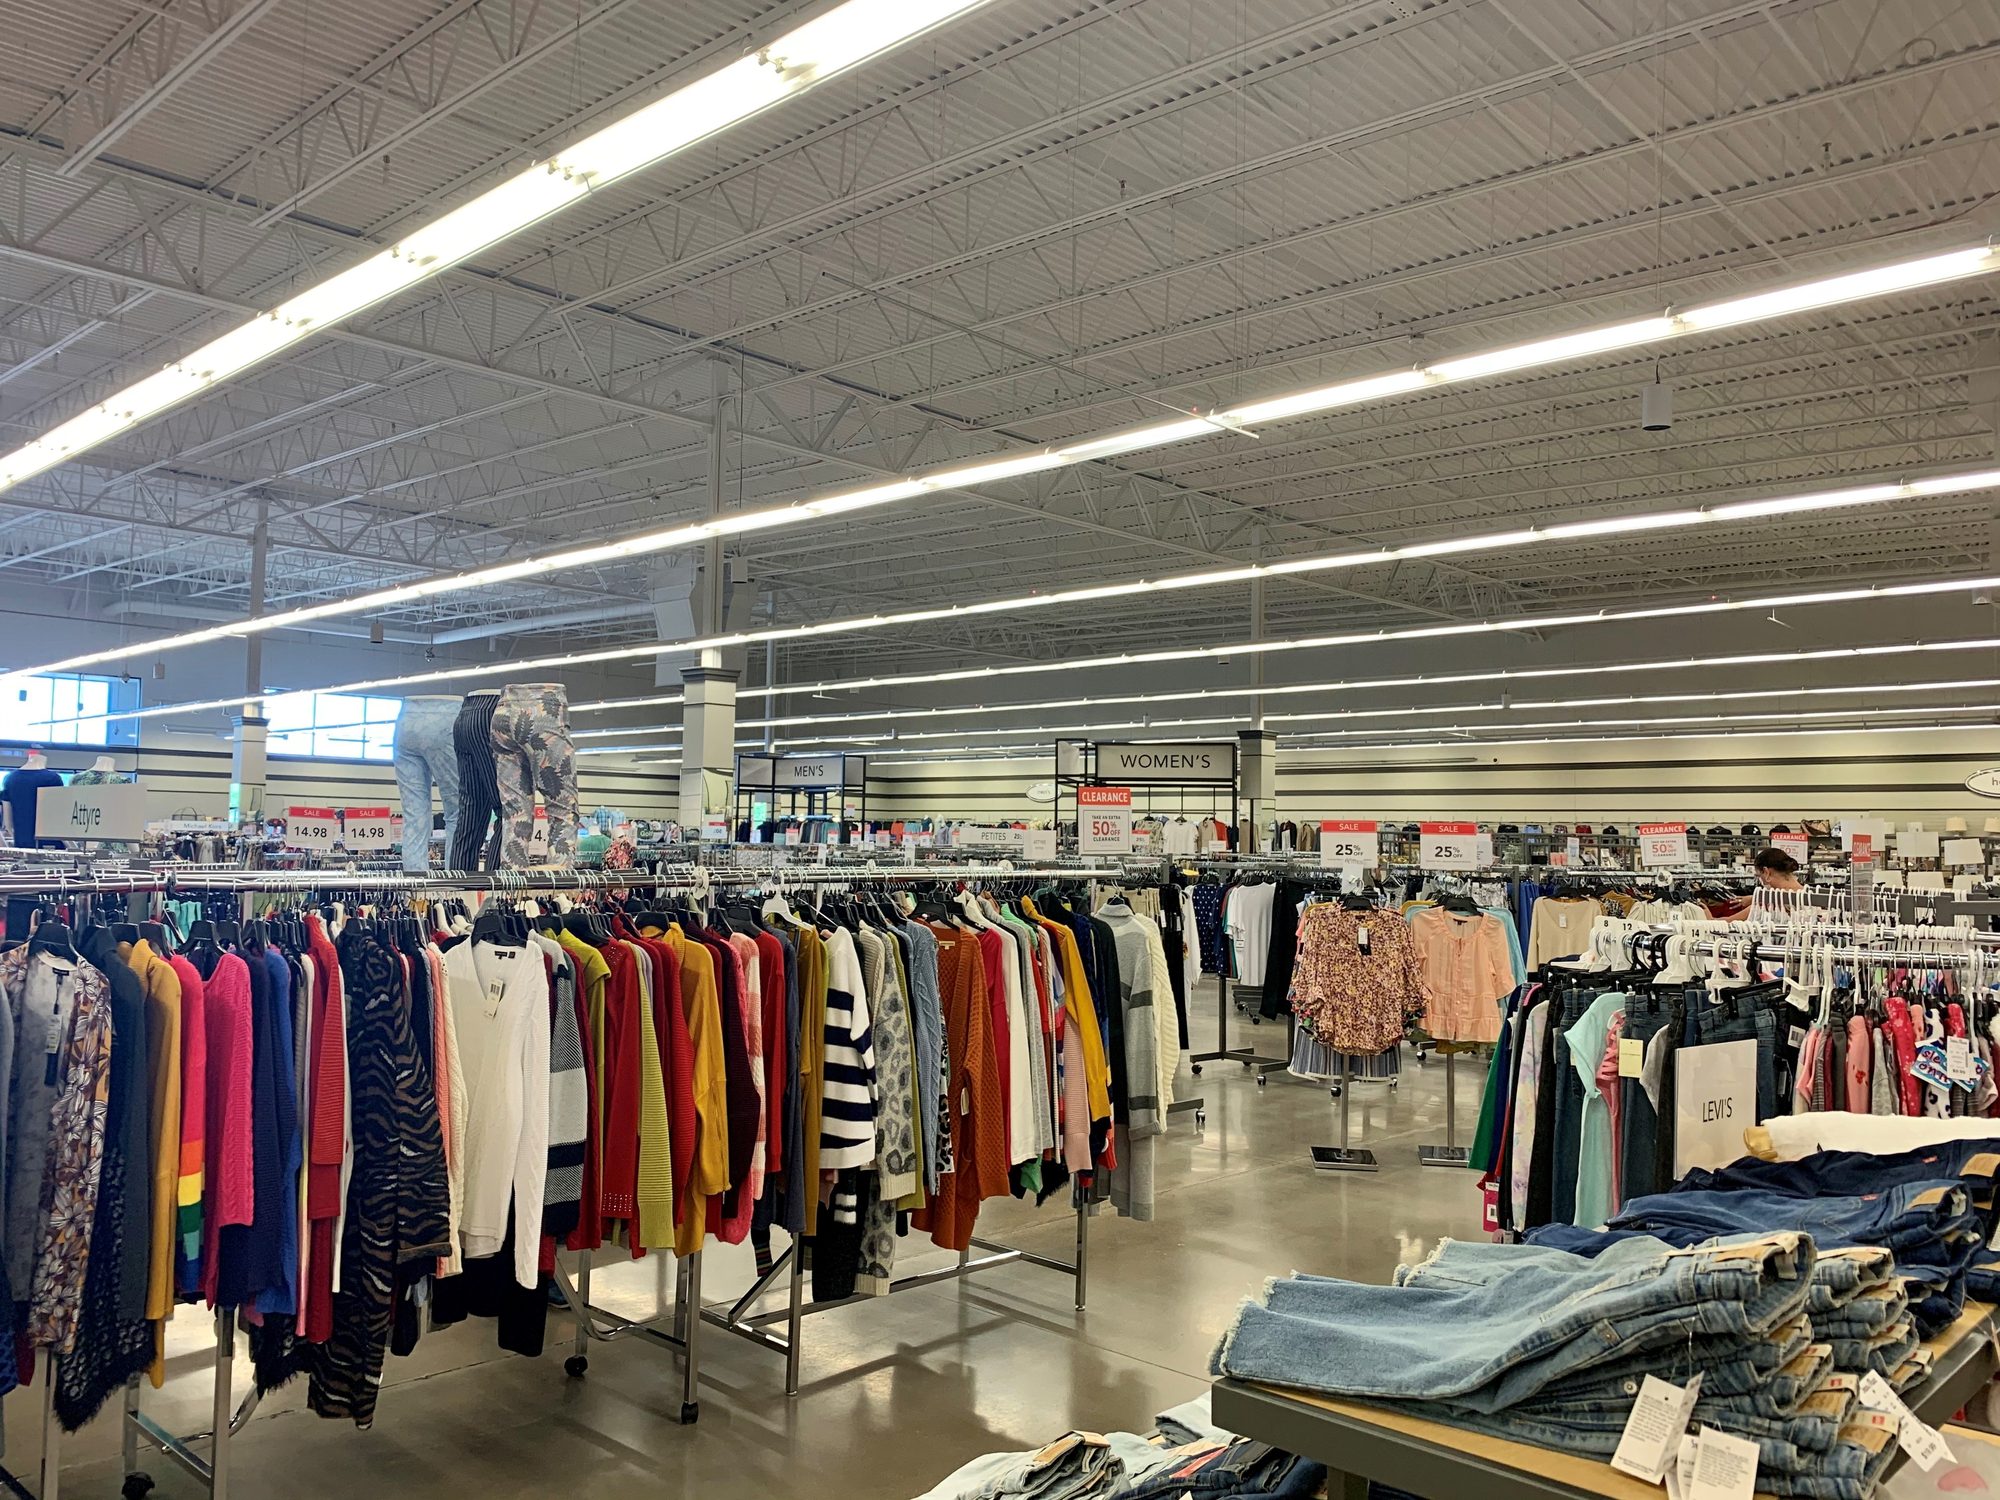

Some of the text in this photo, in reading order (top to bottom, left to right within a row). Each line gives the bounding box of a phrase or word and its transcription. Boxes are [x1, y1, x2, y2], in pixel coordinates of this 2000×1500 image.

[1120, 754, 1211, 769] WOMEN'S
[794, 765, 824, 777] MEN'S
[1081, 791, 1128, 803] CLEARANCE
[71, 800, 101, 833] Attyre
[303, 809, 321, 817] SALE
[359, 809, 376, 817] SALE
[294, 826, 328, 838] 14.98
[1339, 823, 1359, 831] SALE
[1438, 825, 1459, 833] SALE
[1641, 825, 1683, 835] CLEARANCE
[351, 827, 385, 839] 14.98
[981, 831, 1007, 841] PETITES
[1622, 923, 1633, 931] 12
[1691, 929, 1700, 938] 14
[1702, 1096, 1733, 1123] LEVI'S
